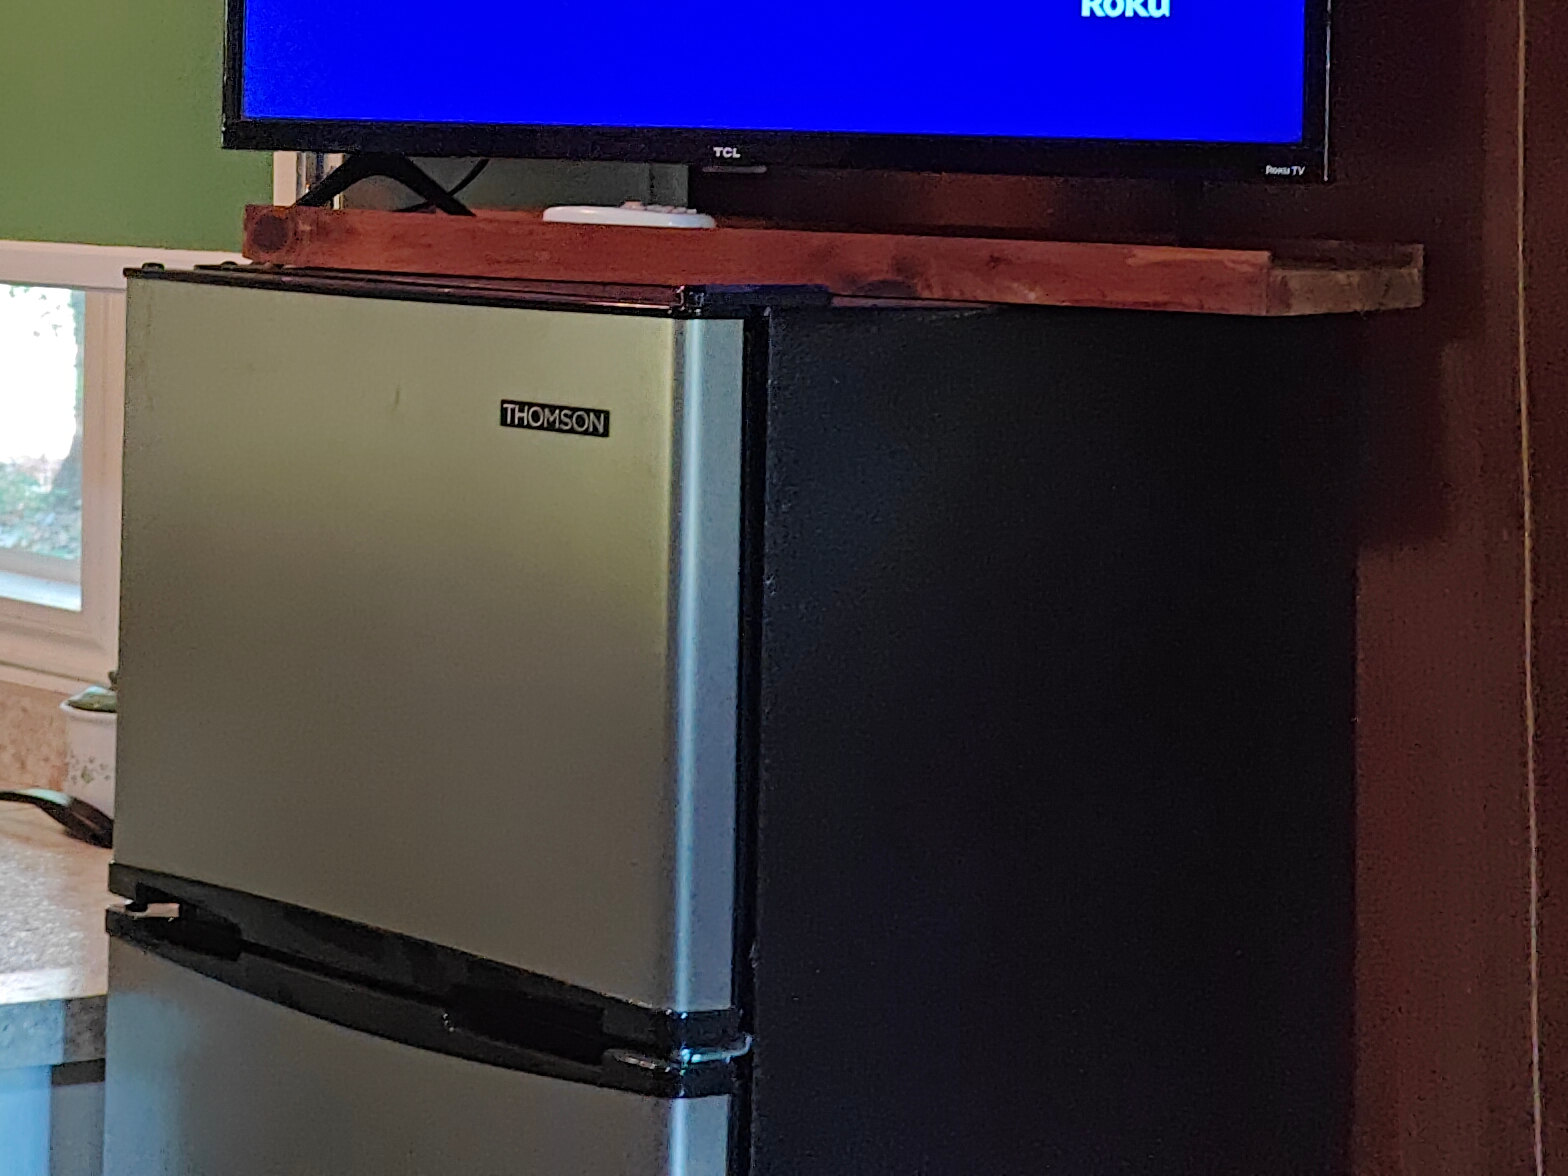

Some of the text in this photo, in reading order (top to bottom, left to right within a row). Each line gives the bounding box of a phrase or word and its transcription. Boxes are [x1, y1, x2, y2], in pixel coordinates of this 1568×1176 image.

[713, 146, 741, 159] TCL
[1291, 165, 1306, 176] TV
[502, 403, 605, 435] THOMSON
